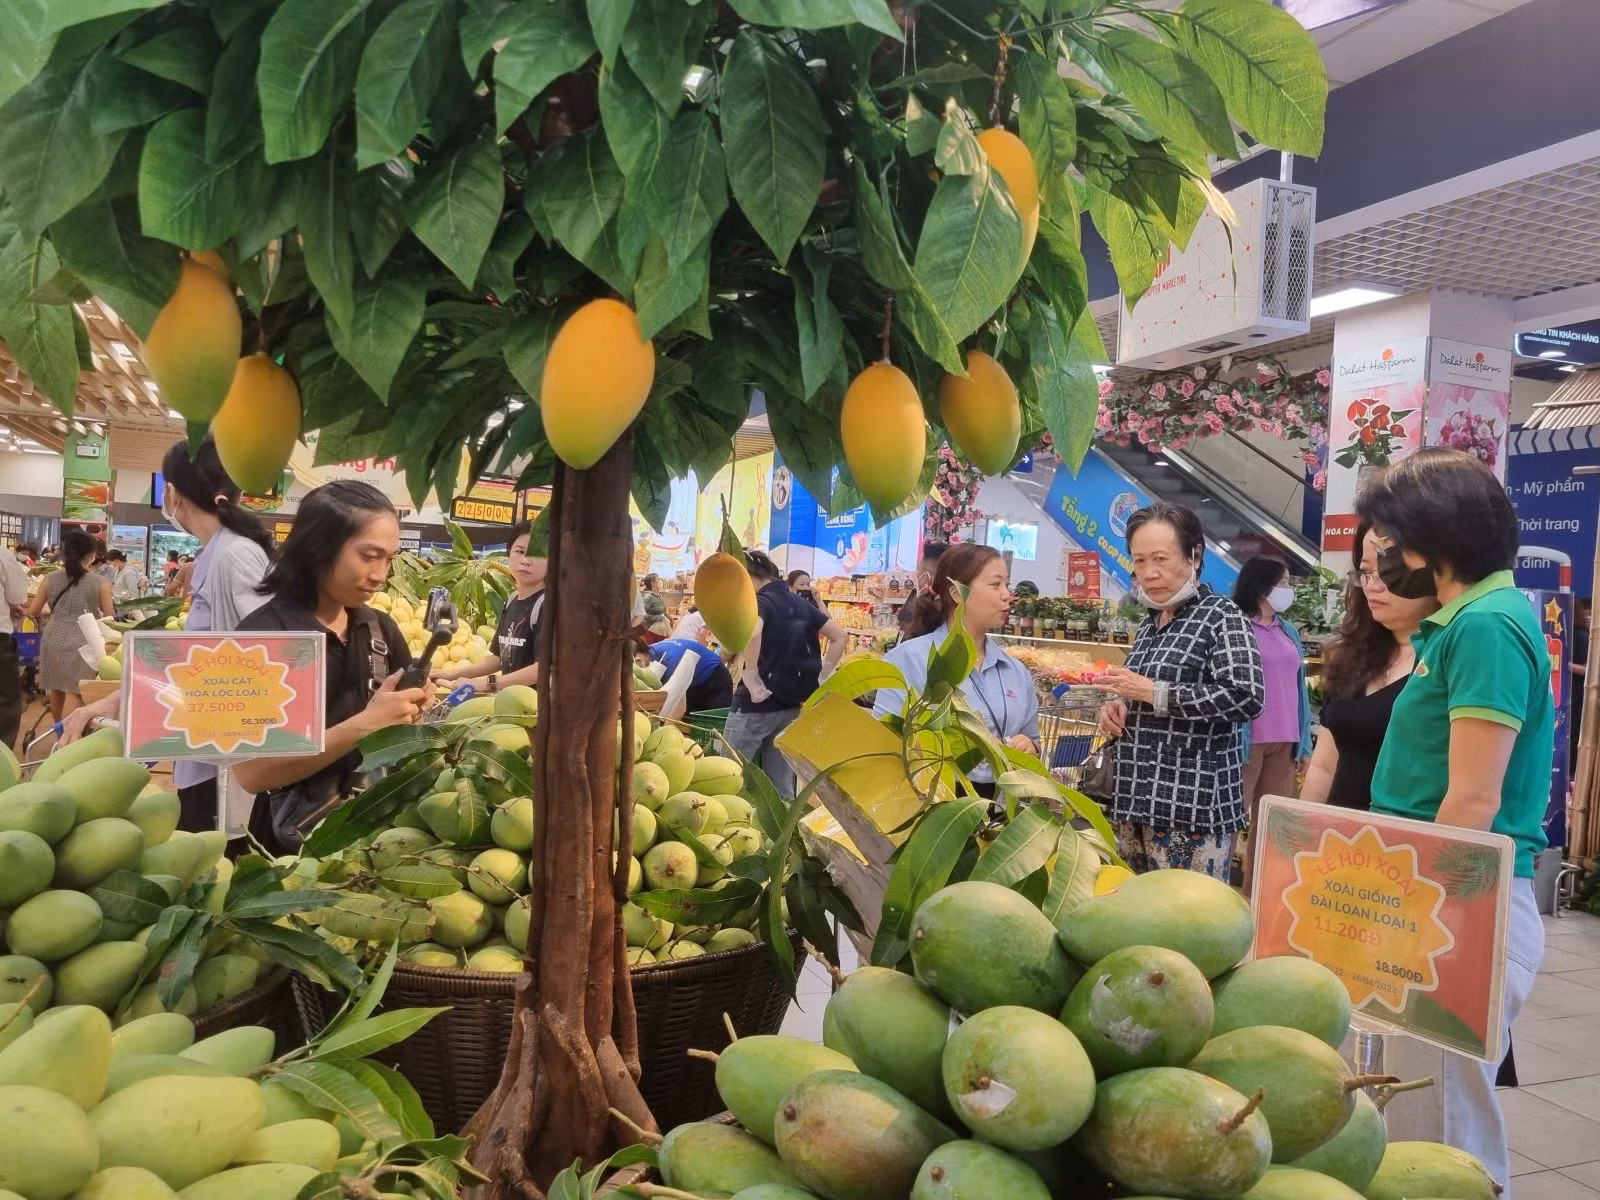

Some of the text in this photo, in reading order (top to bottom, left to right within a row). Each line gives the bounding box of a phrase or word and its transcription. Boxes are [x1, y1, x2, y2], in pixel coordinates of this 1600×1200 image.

[1548, 329, 1558, 338] TIN
[1559, 330, 1581, 341] KHÁCH
[1581, 332, 1599, 343] HÀNG
[1523, 480, 1543, 497] Mỹ
[1546, 476, 1585, 496] phẩm
[1062, 495, 1089, 534] Tầng
[1087, 520, 1098, 538] 2
[1545, 519, 1580, 533] trang
[1325, 527, 1342, 535] HOA
[1323, 879, 1401, 909] XOÀI GIỐNG
[1311, 894, 1418, 934] ĐÀI LOAN LOẠI 1
[1314, 916, 1382, 946] 11.200Đ
[1375, 960, 1424, 984] 18.800Đ
